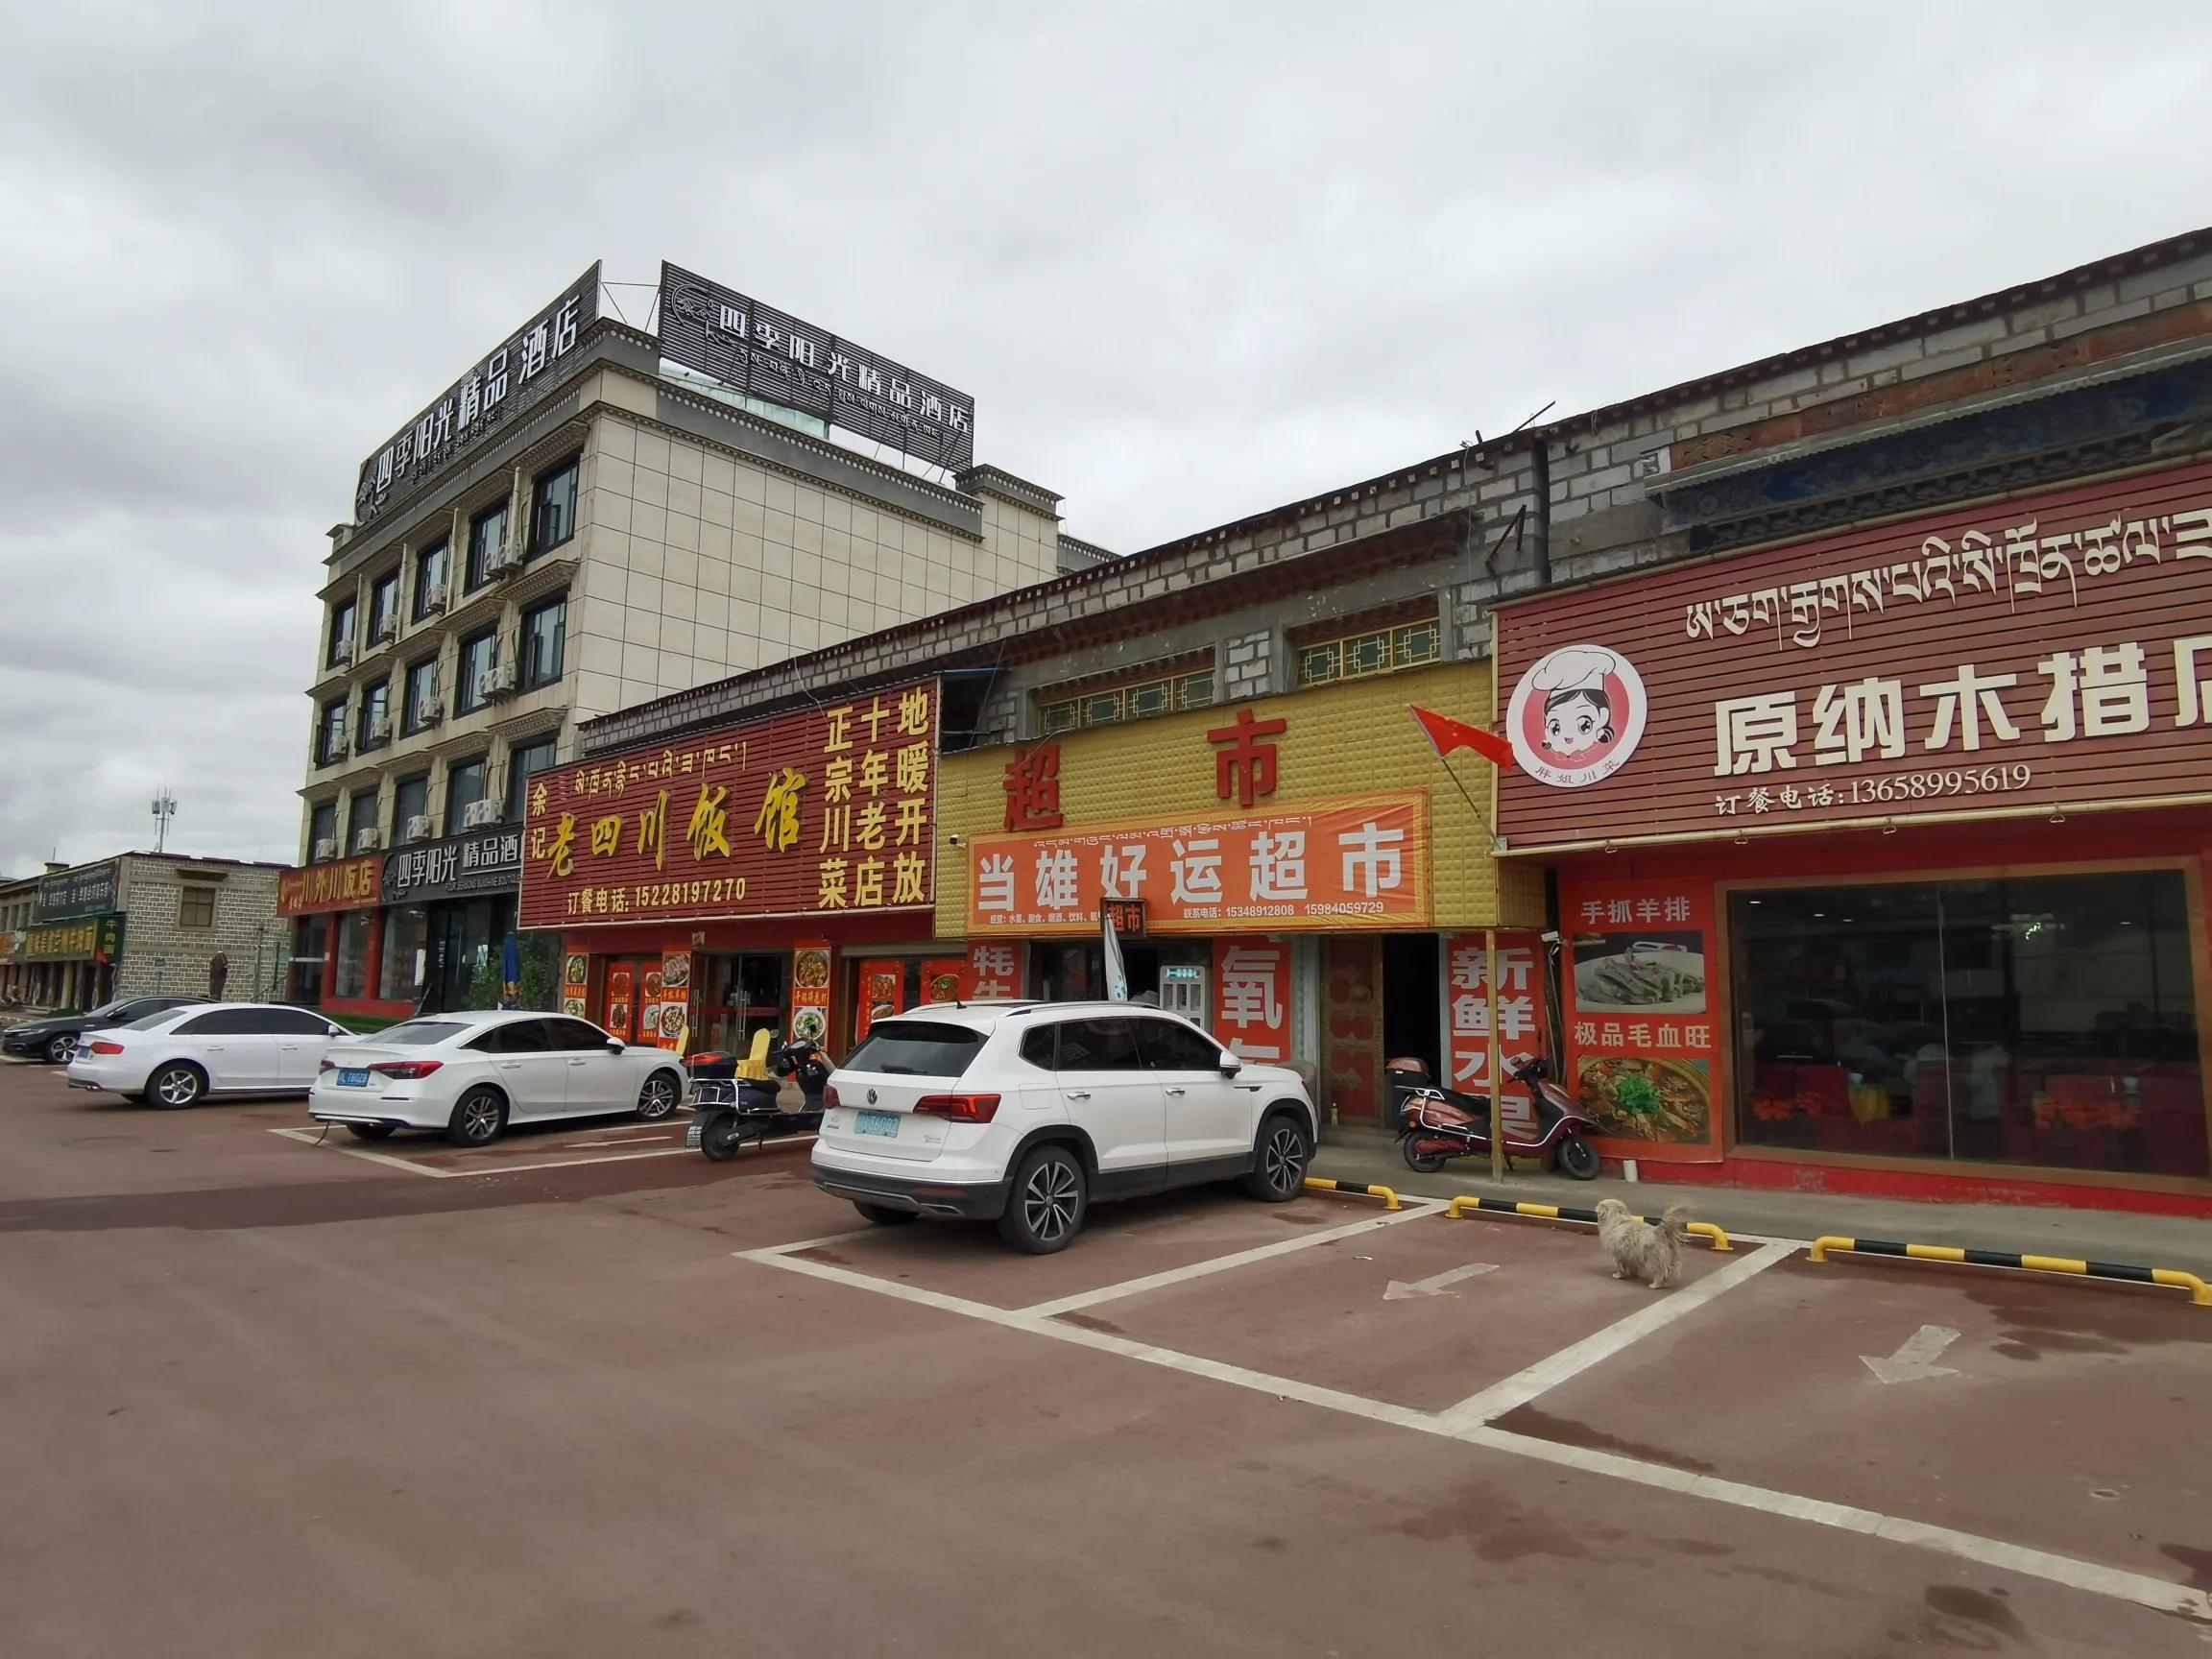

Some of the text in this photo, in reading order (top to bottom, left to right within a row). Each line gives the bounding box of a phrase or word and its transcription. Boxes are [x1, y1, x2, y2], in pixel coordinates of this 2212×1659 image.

[376, 295, 580, 493] 四季阳光精品酒店
[720, 304, 970, 433] 四季阳光精品酒店
[546, 768, 808, 878] 老四川饭馆
[819, 705, 854, 909] 正宗川菜
[855, 697, 890, 907] 十年老店
[893, 686, 929, 904] 地暖开放
[1001, 708, 1287, 831] 超市
[977, 823, 1404, 912] 当雄好运超市
[1108, 904, 1141, 932] 超市
[1304, 902, 1383, 915] 15984059729
[1581, 896, 1691, 925] 手抓羊排
[1221, 945, 1283, 1060] 氧
[1574, 1022, 1712, 1048] 极品毛血旺
